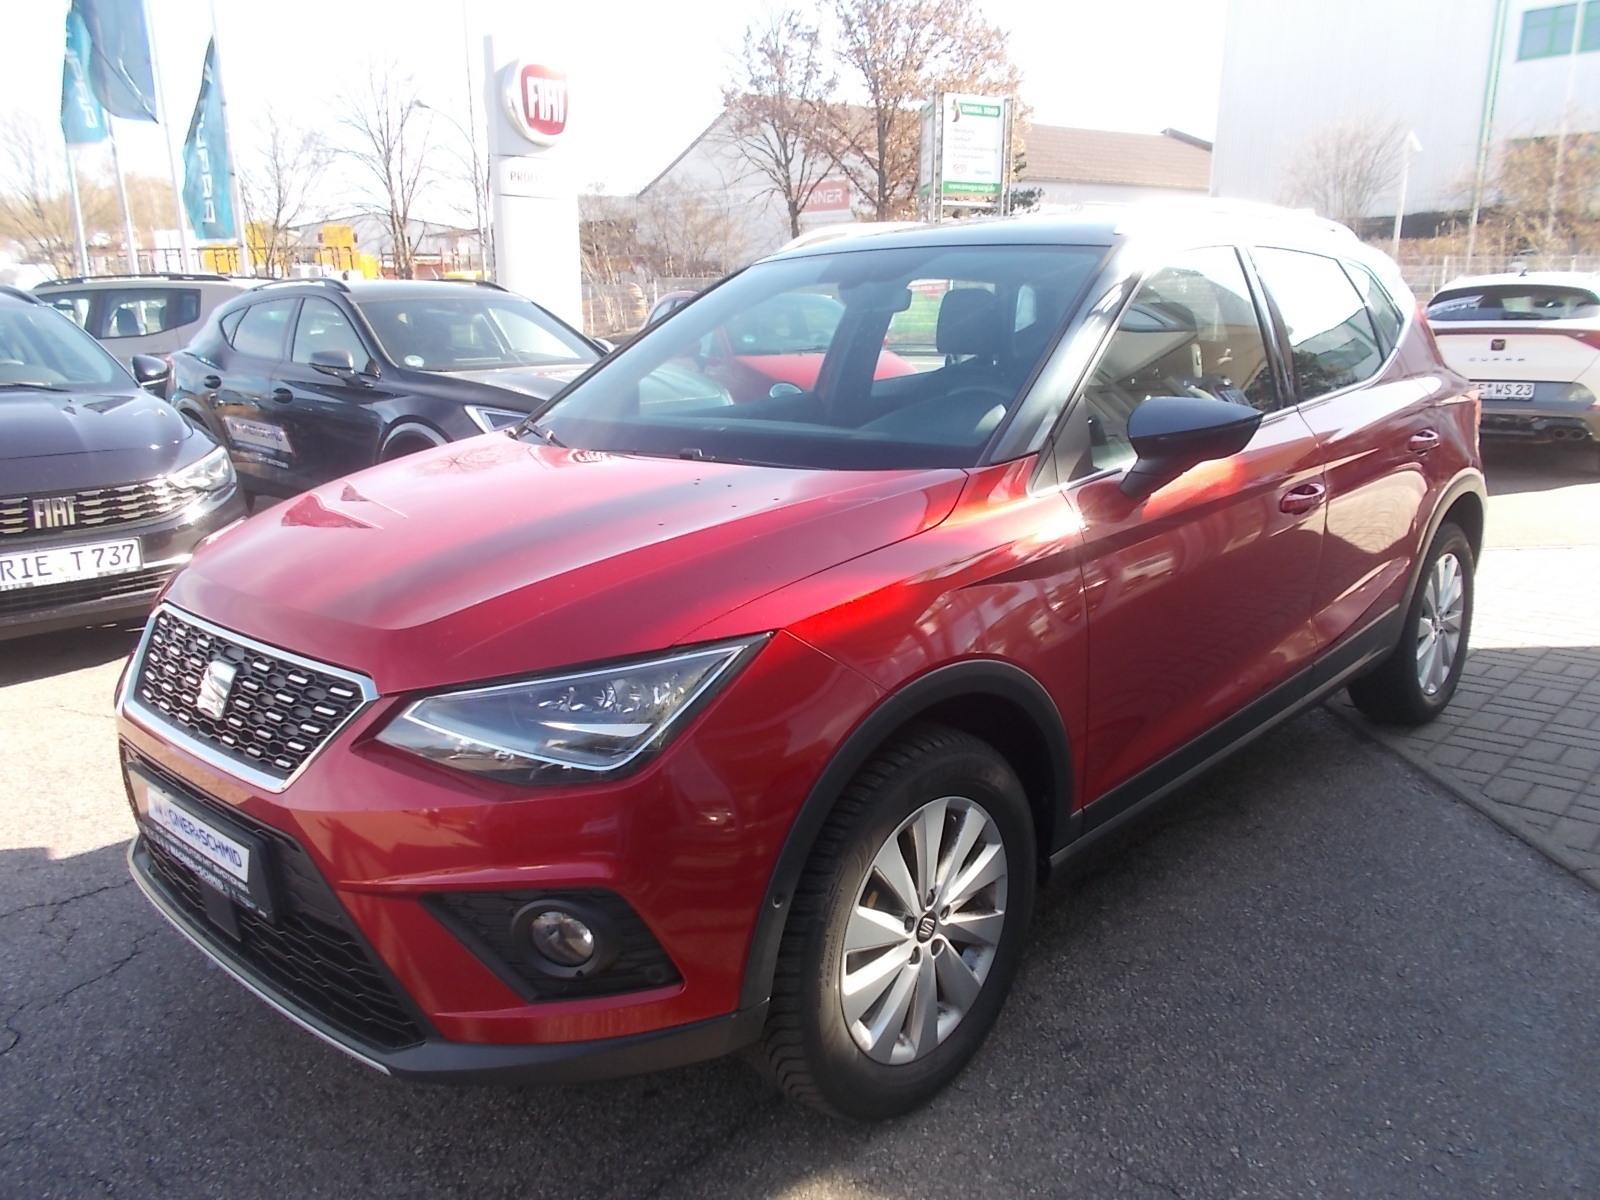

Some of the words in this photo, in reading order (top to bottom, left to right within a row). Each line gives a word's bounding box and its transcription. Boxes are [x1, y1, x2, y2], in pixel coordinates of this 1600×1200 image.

[526, 76, 568, 124] FIAT
[1495, 383, 1512, 395] WS
[1515, 384, 1532, 396] 23
[32, 495, 77, 529] FIAT
[0, 554, 52, 581] RIE
[70, 550, 83, 571] T
[91, 543, 134, 568] 737
